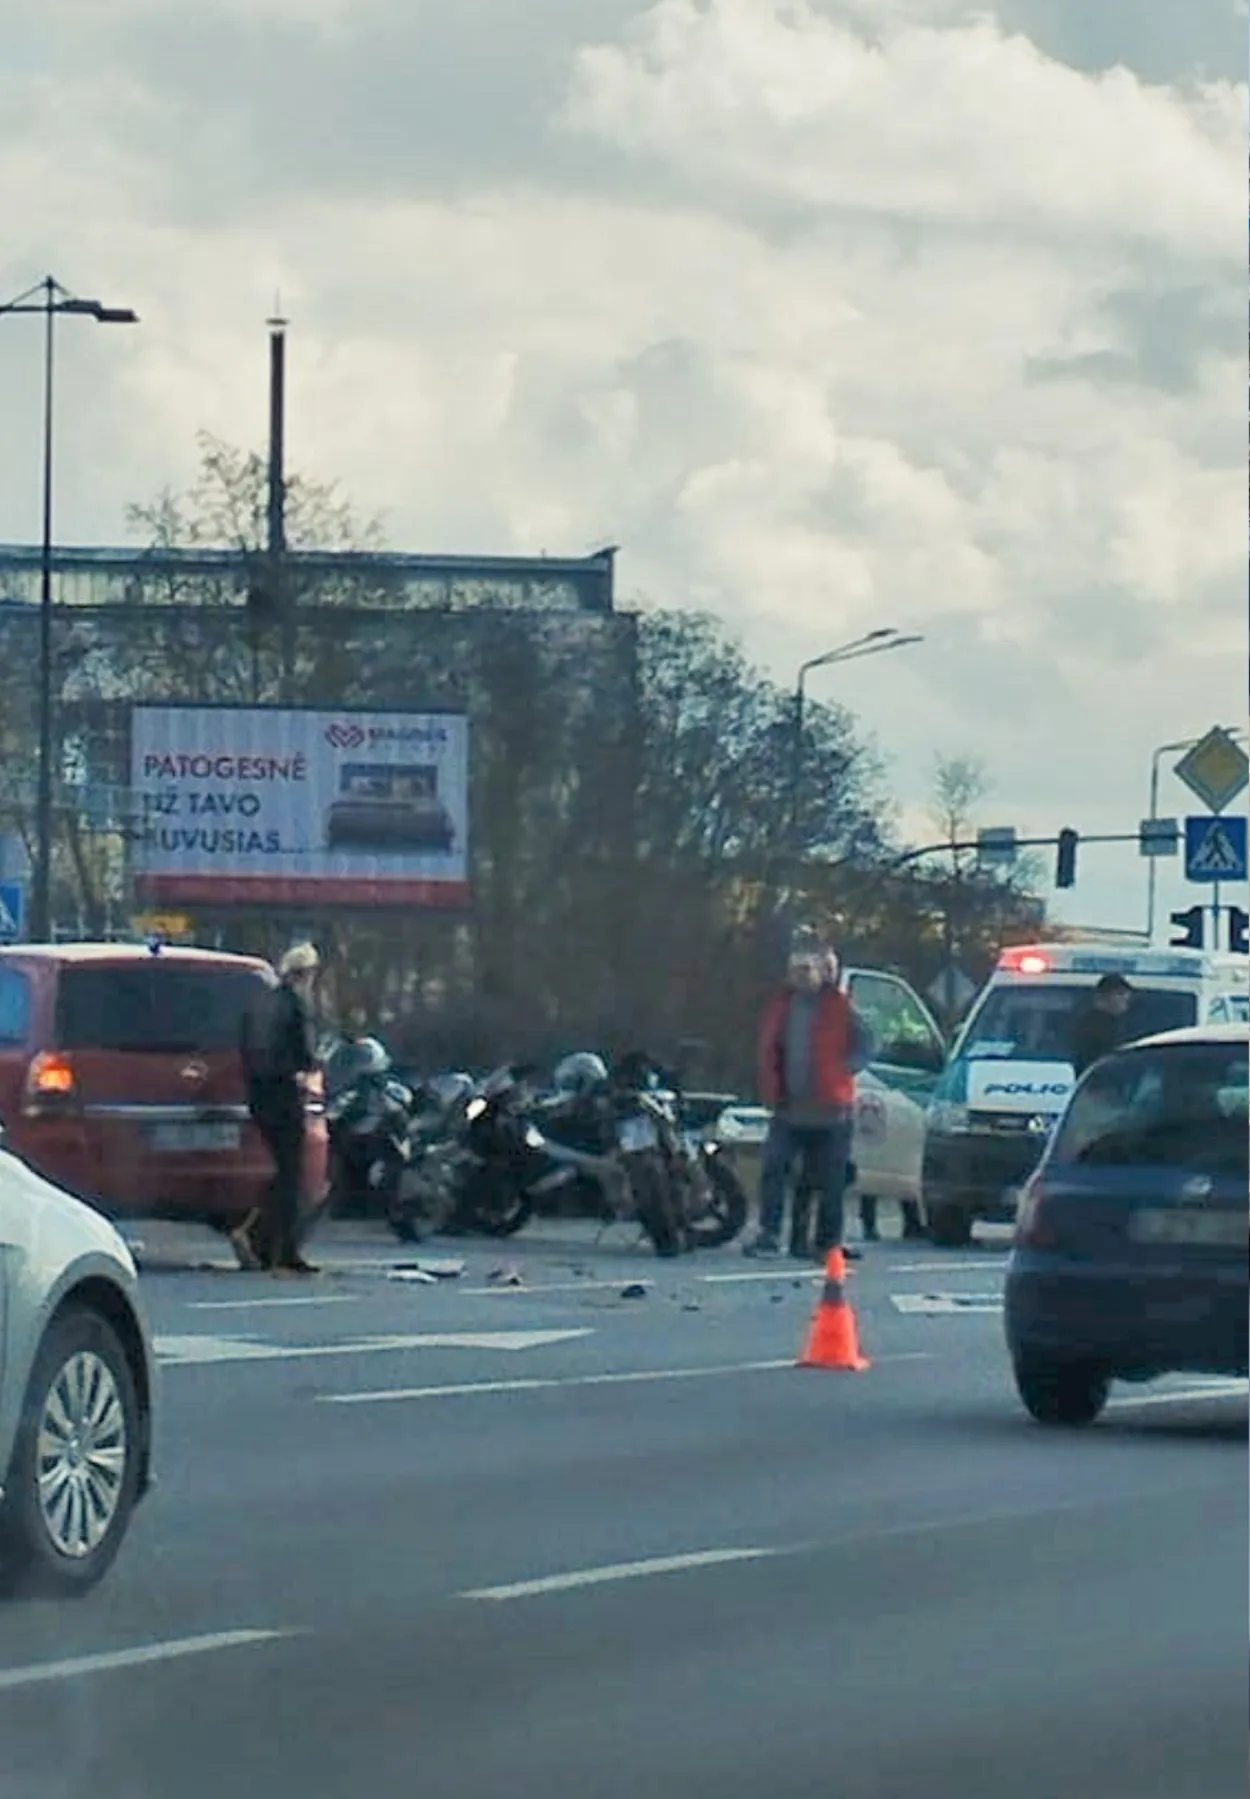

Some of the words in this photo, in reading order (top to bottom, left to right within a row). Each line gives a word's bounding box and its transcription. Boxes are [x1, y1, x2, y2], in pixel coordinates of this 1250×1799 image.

[144, 752, 307, 781] PATOGESNĖ
[188, 792, 260, 817] TAVO
[984, 1083, 1070, 1096] POLIC
